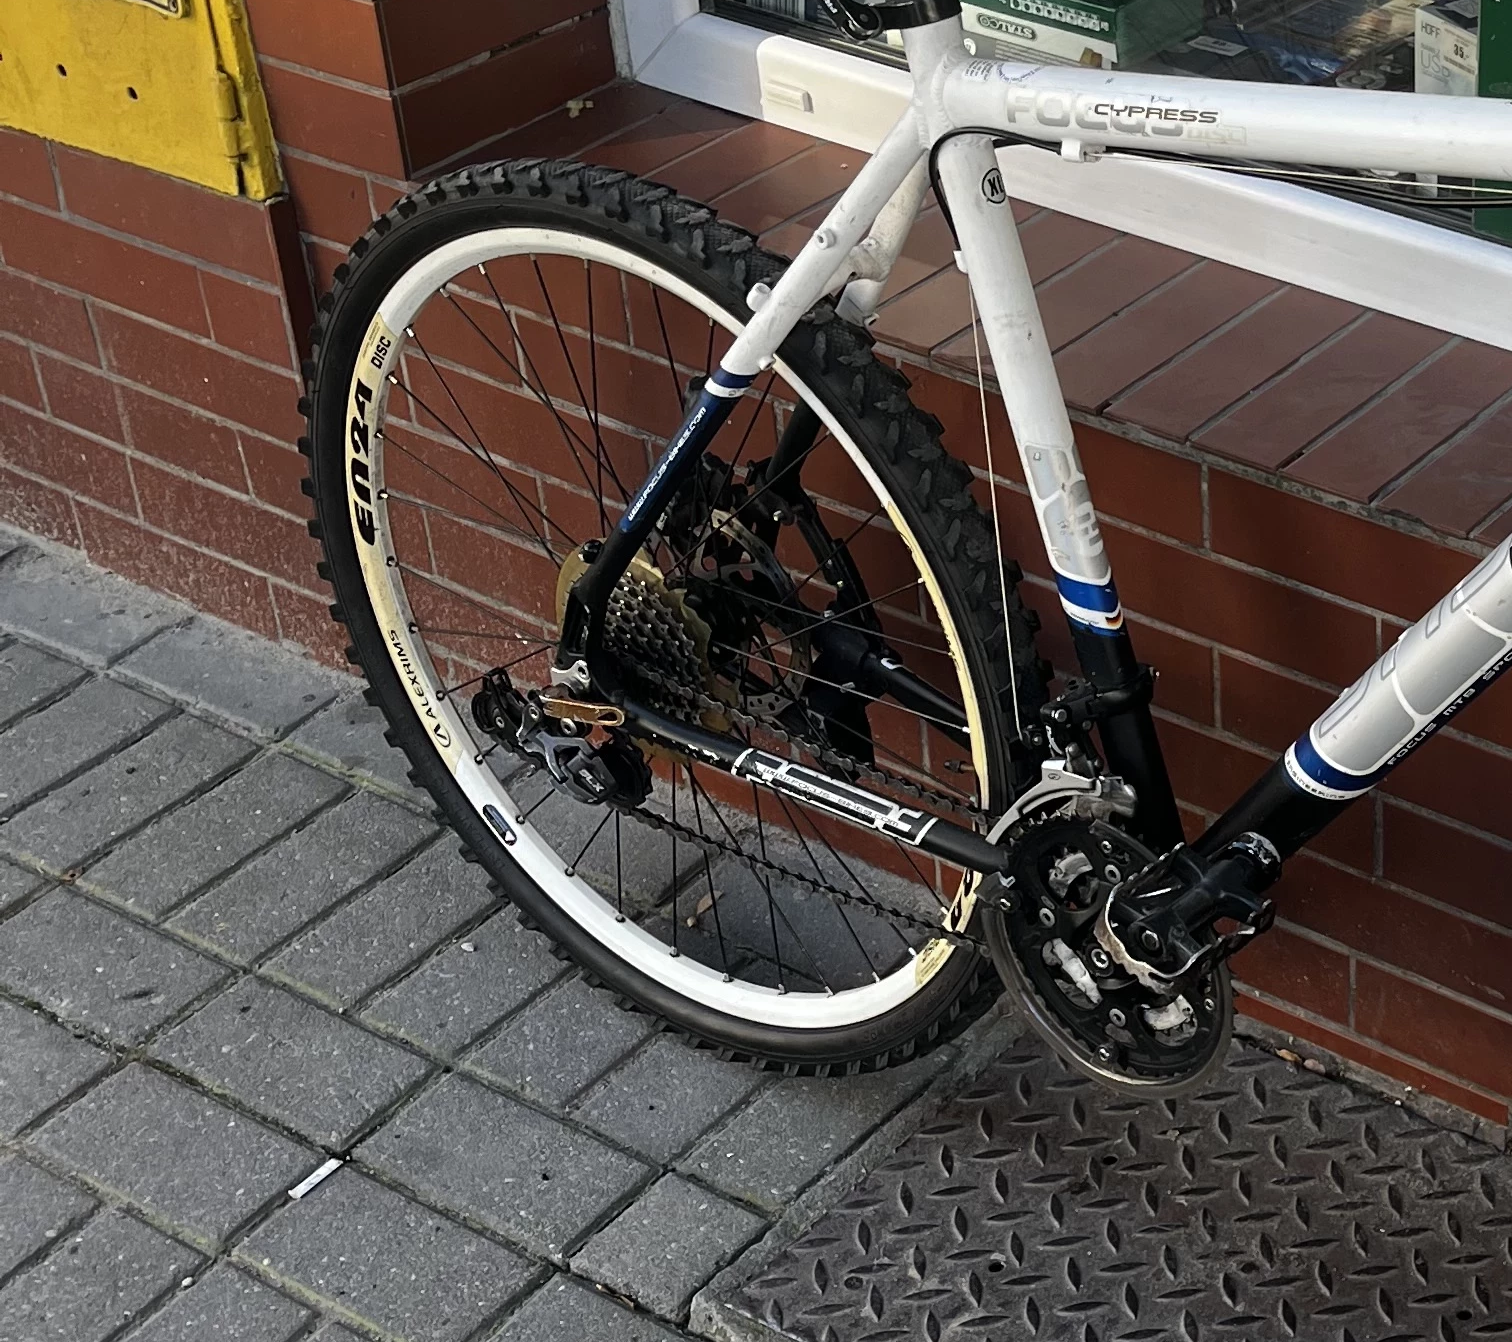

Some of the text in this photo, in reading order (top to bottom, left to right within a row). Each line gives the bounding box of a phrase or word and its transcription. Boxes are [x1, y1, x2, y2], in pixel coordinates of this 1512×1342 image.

[979, 13, 1035, 39] STALCO
[1094, 103, 1219, 124] CYPRESS
[370, 335, 393, 370] DISC
[388, 628, 434, 718] ALEXRIMS
[1387, 722, 1437, 766] FOCUS
[1442, 688, 1477, 716] MTB
[578, 768, 605, 793] SLX
